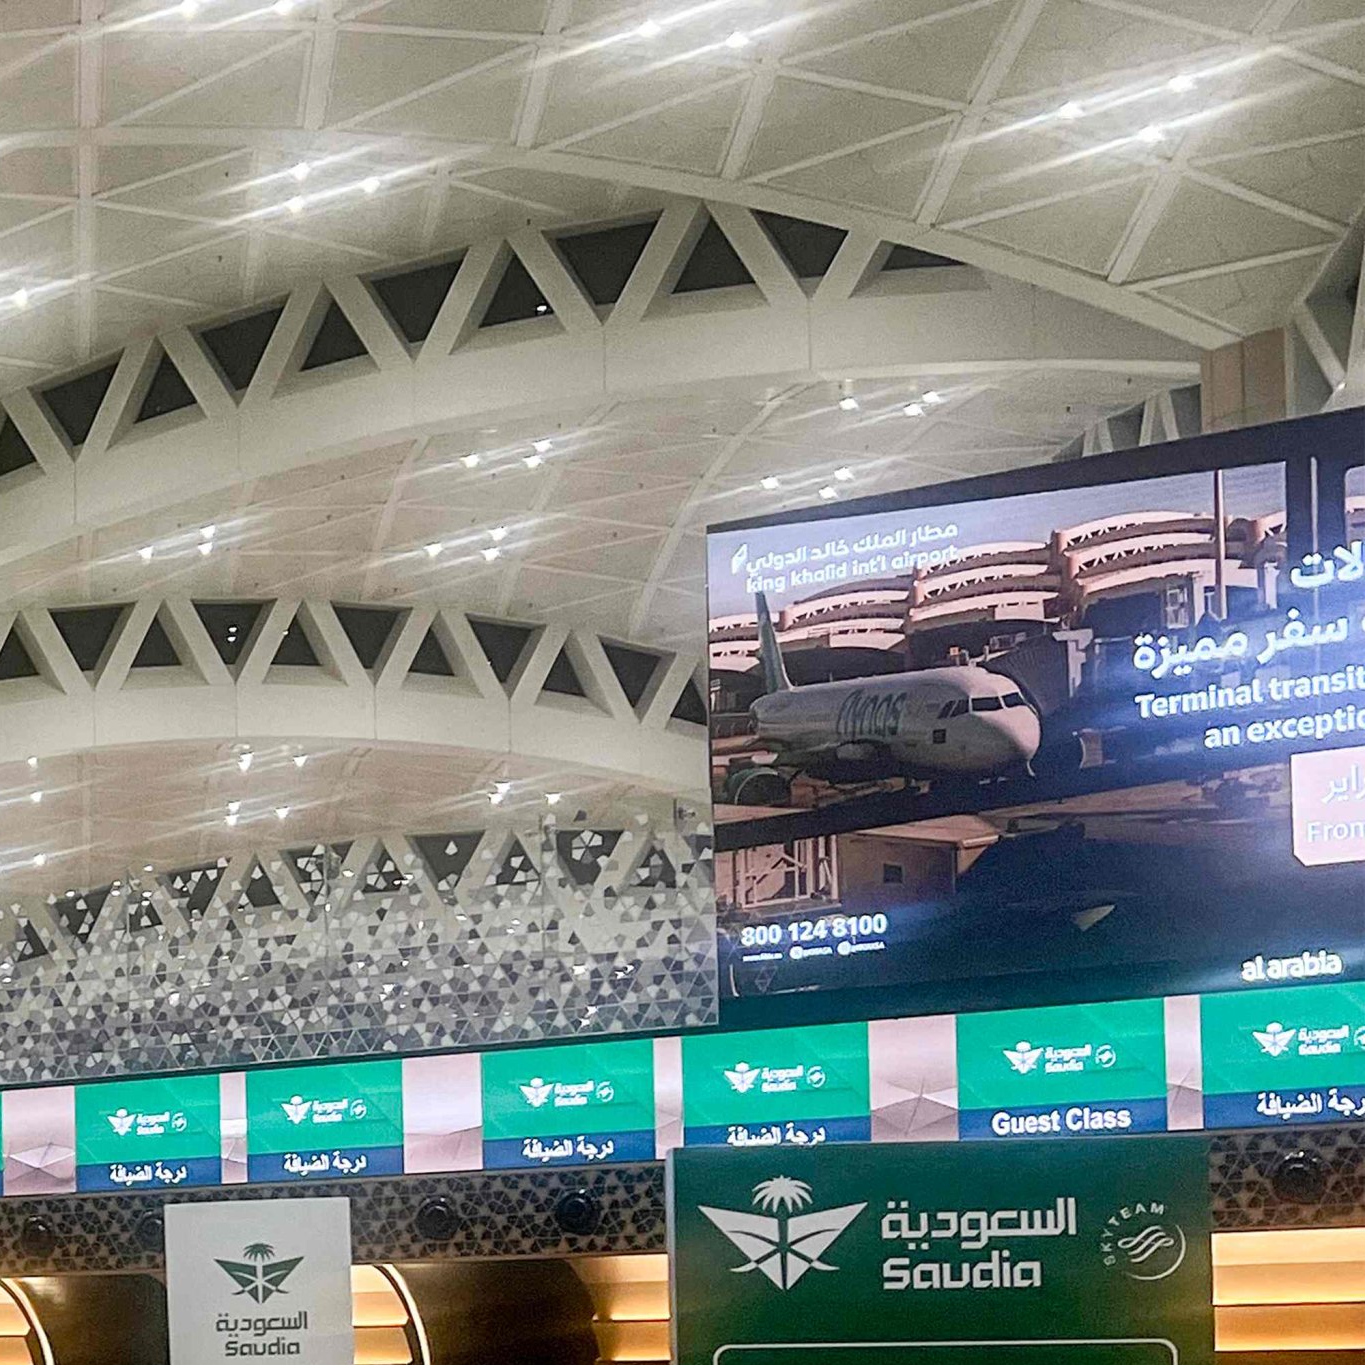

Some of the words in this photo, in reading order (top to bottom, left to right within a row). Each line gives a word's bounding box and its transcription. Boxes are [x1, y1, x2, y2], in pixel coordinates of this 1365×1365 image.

[812, 541, 848, 559] خالد
[853, 530, 906, 551] الملك
[910, 523, 958, 547] مطار
[746, 546, 806, 578] الدولي
[746, 575, 786, 593] king
[791, 564, 846, 587] khalid
[892, 545, 959, 570] airport
[1257, 607, 1348, 664] سفر
[1133, 632, 1248, 679] مميزة
[1135, 678, 1263, 718] Terminal
[1204, 724, 1240, 749] an
[741, 924, 782, 946] 800
[788, 919, 828, 941] 124
[832, 913, 888, 938] 8100
[1241, 955, 1266, 981] al
[1267, 950, 1342, 979] arabia
[1257, 1092, 1322, 1119] الضيافة
[1328, 1088, 1365, 1116] رجة
[992, 1110, 1061, 1135] Guest
[1065, 1107, 1131, 1131] Class
[881, 1197, 1076, 1249] السعودية
[1100, 1202, 1165, 1267] SKYTEAM
[882, 1251, 1042, 1289] Saudia
[216, 1311, 308, 1337] السعودية
[225, 1336, 300, 1357] Saudia
